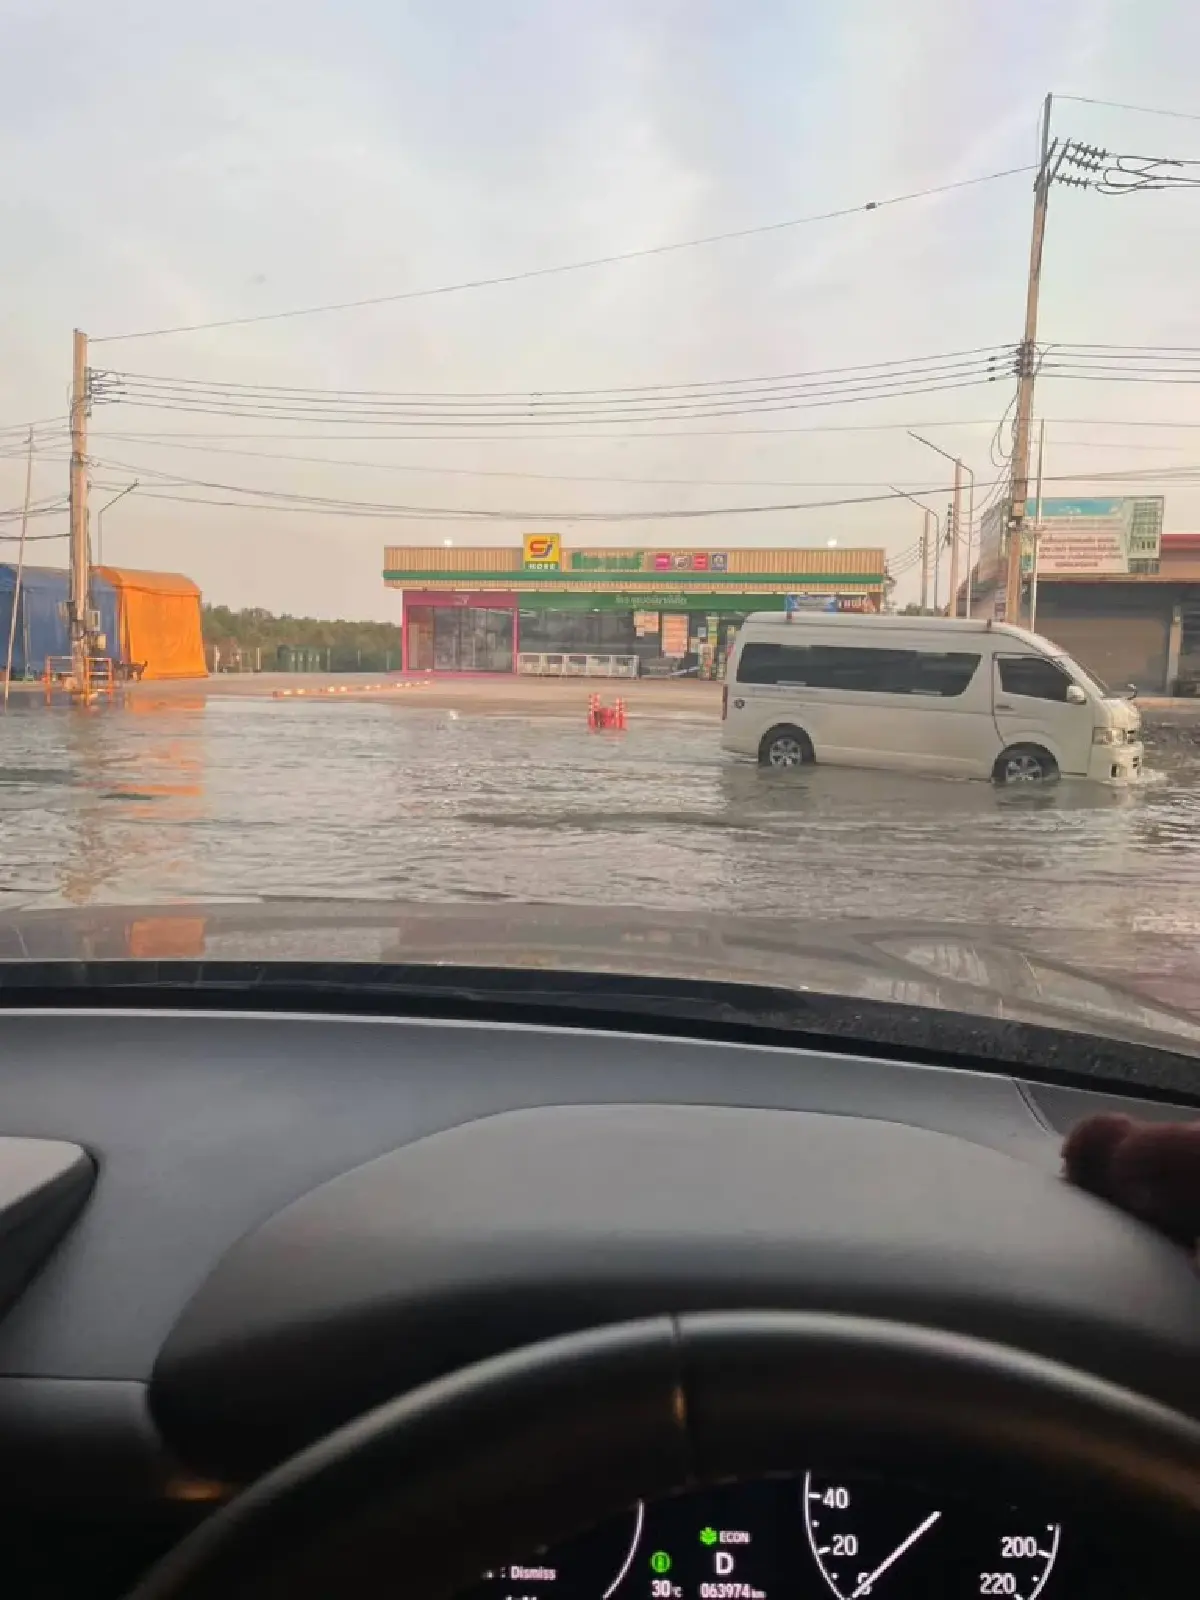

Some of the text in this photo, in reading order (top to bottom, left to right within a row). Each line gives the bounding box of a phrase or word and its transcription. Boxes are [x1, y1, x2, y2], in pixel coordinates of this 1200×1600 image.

[823, 1487, 849, 1508] 40
[832, 1534, 858, 1556] 20
[1001, 1536, 1037, 1558] 200
[511, 1565, 556, 1581] Dismiss
[716, 1551, 734, 1575] D
[980, 1572, 1016, 1594] 220
